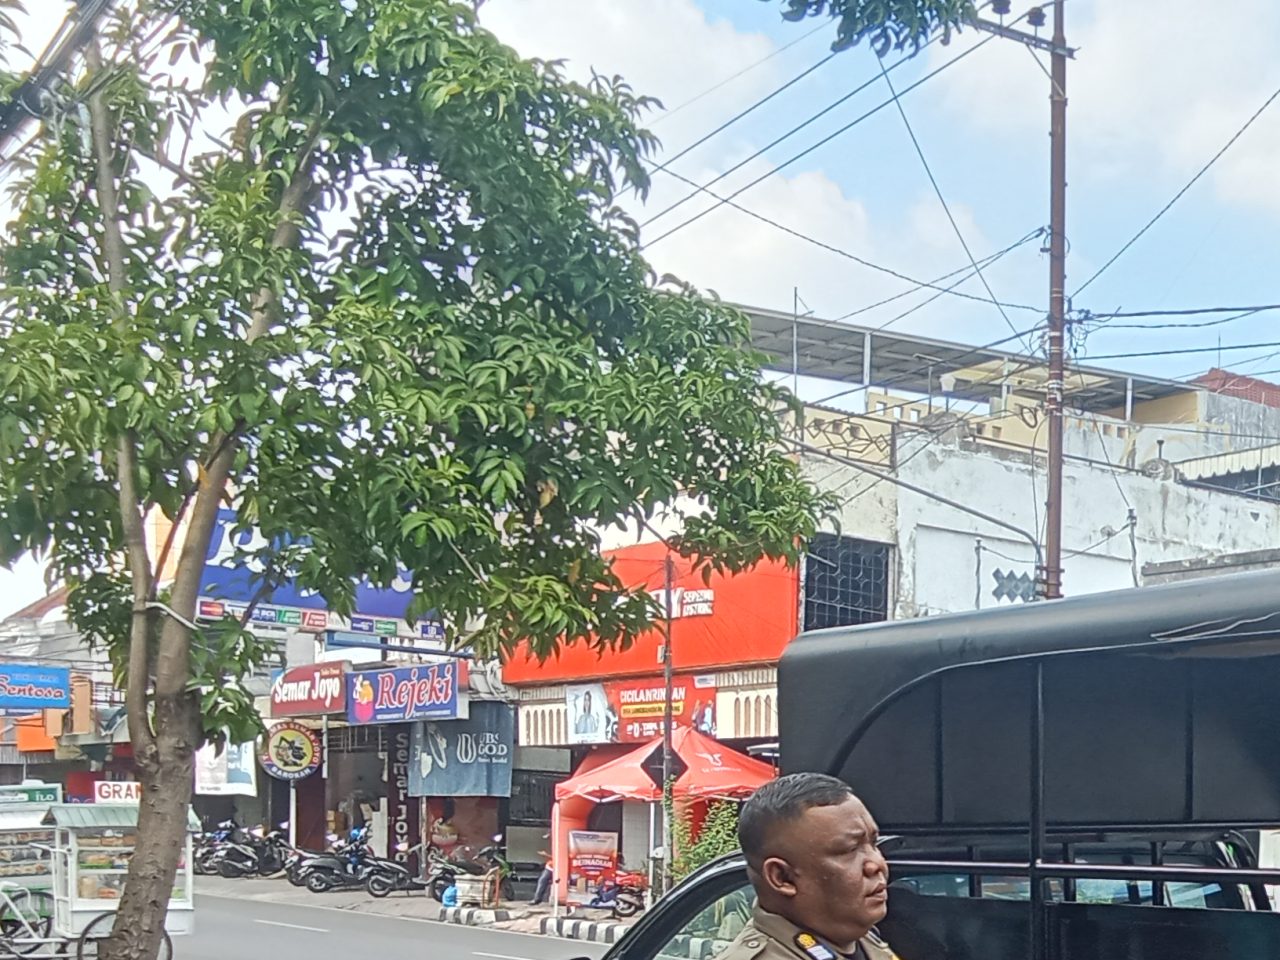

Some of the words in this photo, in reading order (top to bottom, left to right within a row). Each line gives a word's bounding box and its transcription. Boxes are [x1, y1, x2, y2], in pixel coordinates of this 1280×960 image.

[274, 677, 311, 704] Semar
[311, 671, 340, 708] Joyo
[375, 664, 452, 719] Rejeki
[651, 687, 686, 701] RINAN
[394, 733, 408, 801] Semar
[478, 743, 508, 756] GOD
